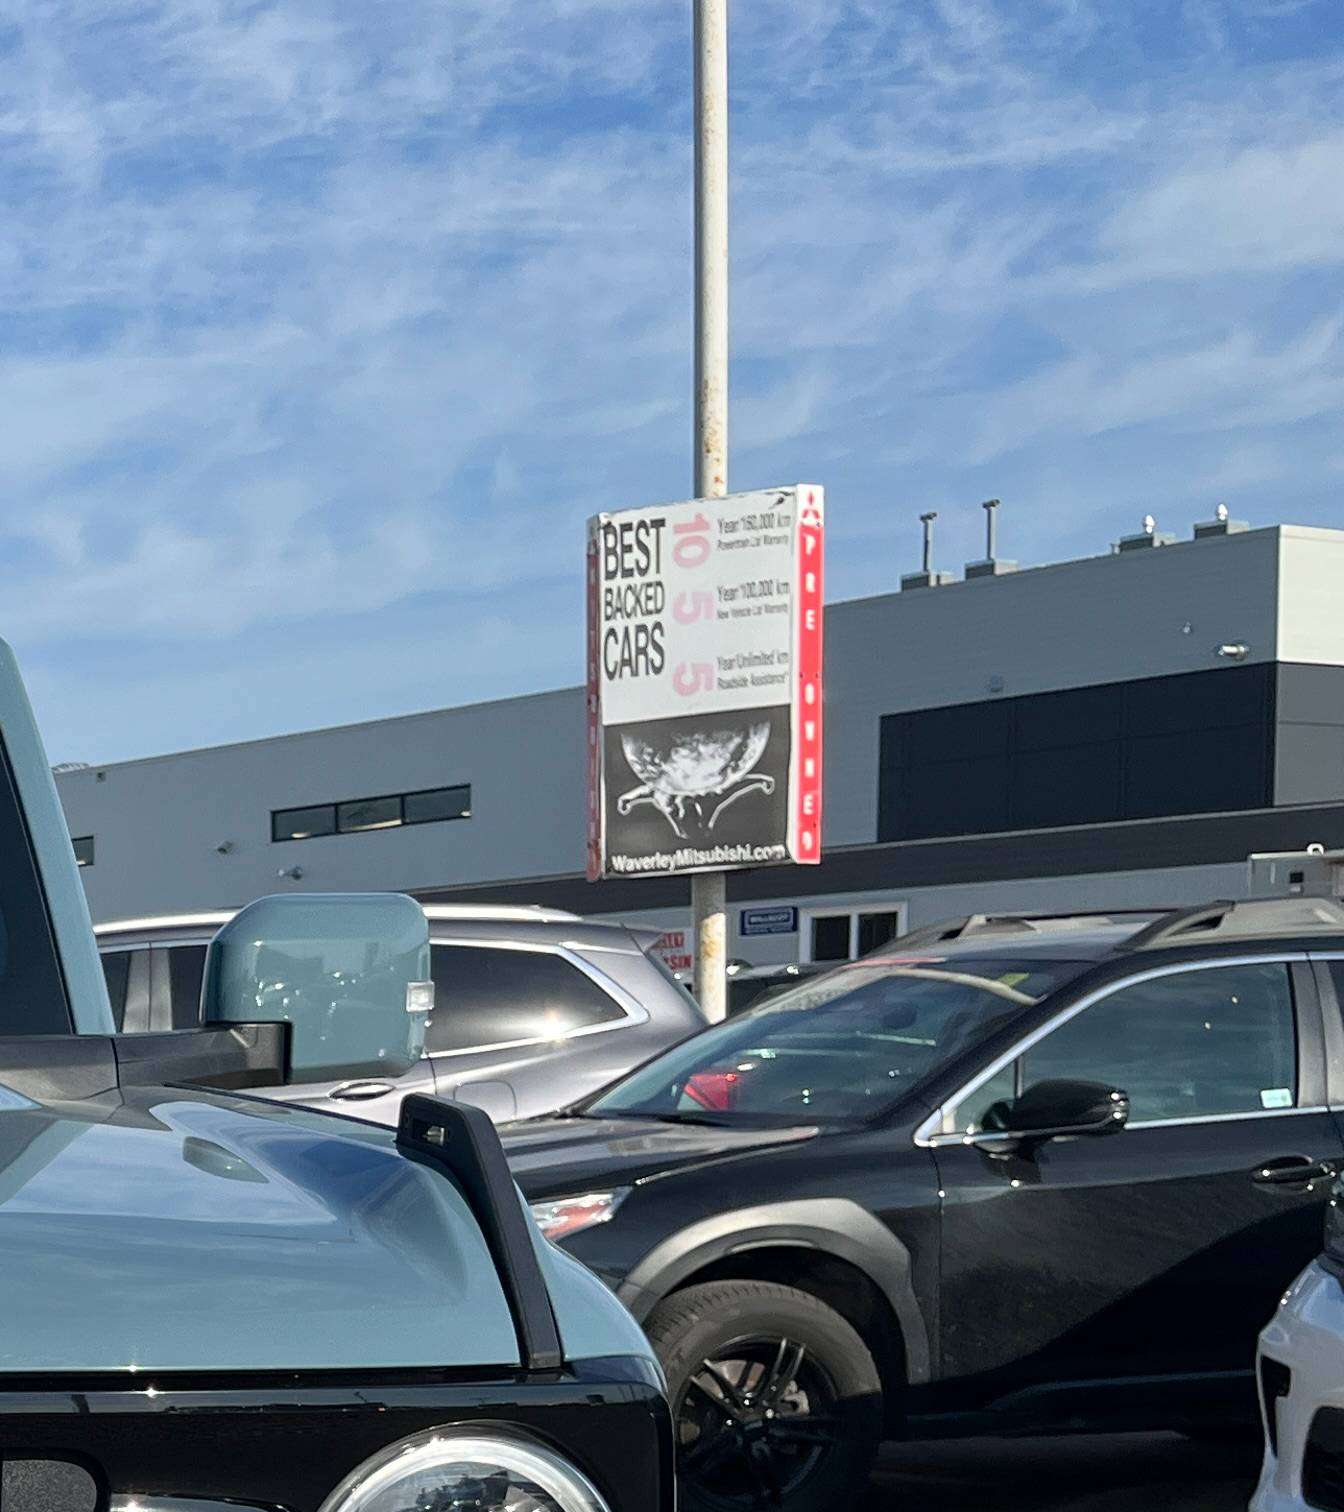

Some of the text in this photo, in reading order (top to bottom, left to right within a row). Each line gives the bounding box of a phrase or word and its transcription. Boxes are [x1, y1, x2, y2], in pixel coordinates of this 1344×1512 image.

[603, 518, 666, 580] BEST
[673, 512, 711, 569] 10
[605, 581, 665, 621] BACKED
[672, 591, 716, 625] 5
[604, 621, 665, 681] CARS
[672, 662, 715, 696] 5
[612, 844, 785, 872] WaverleyMitsubishi.com
